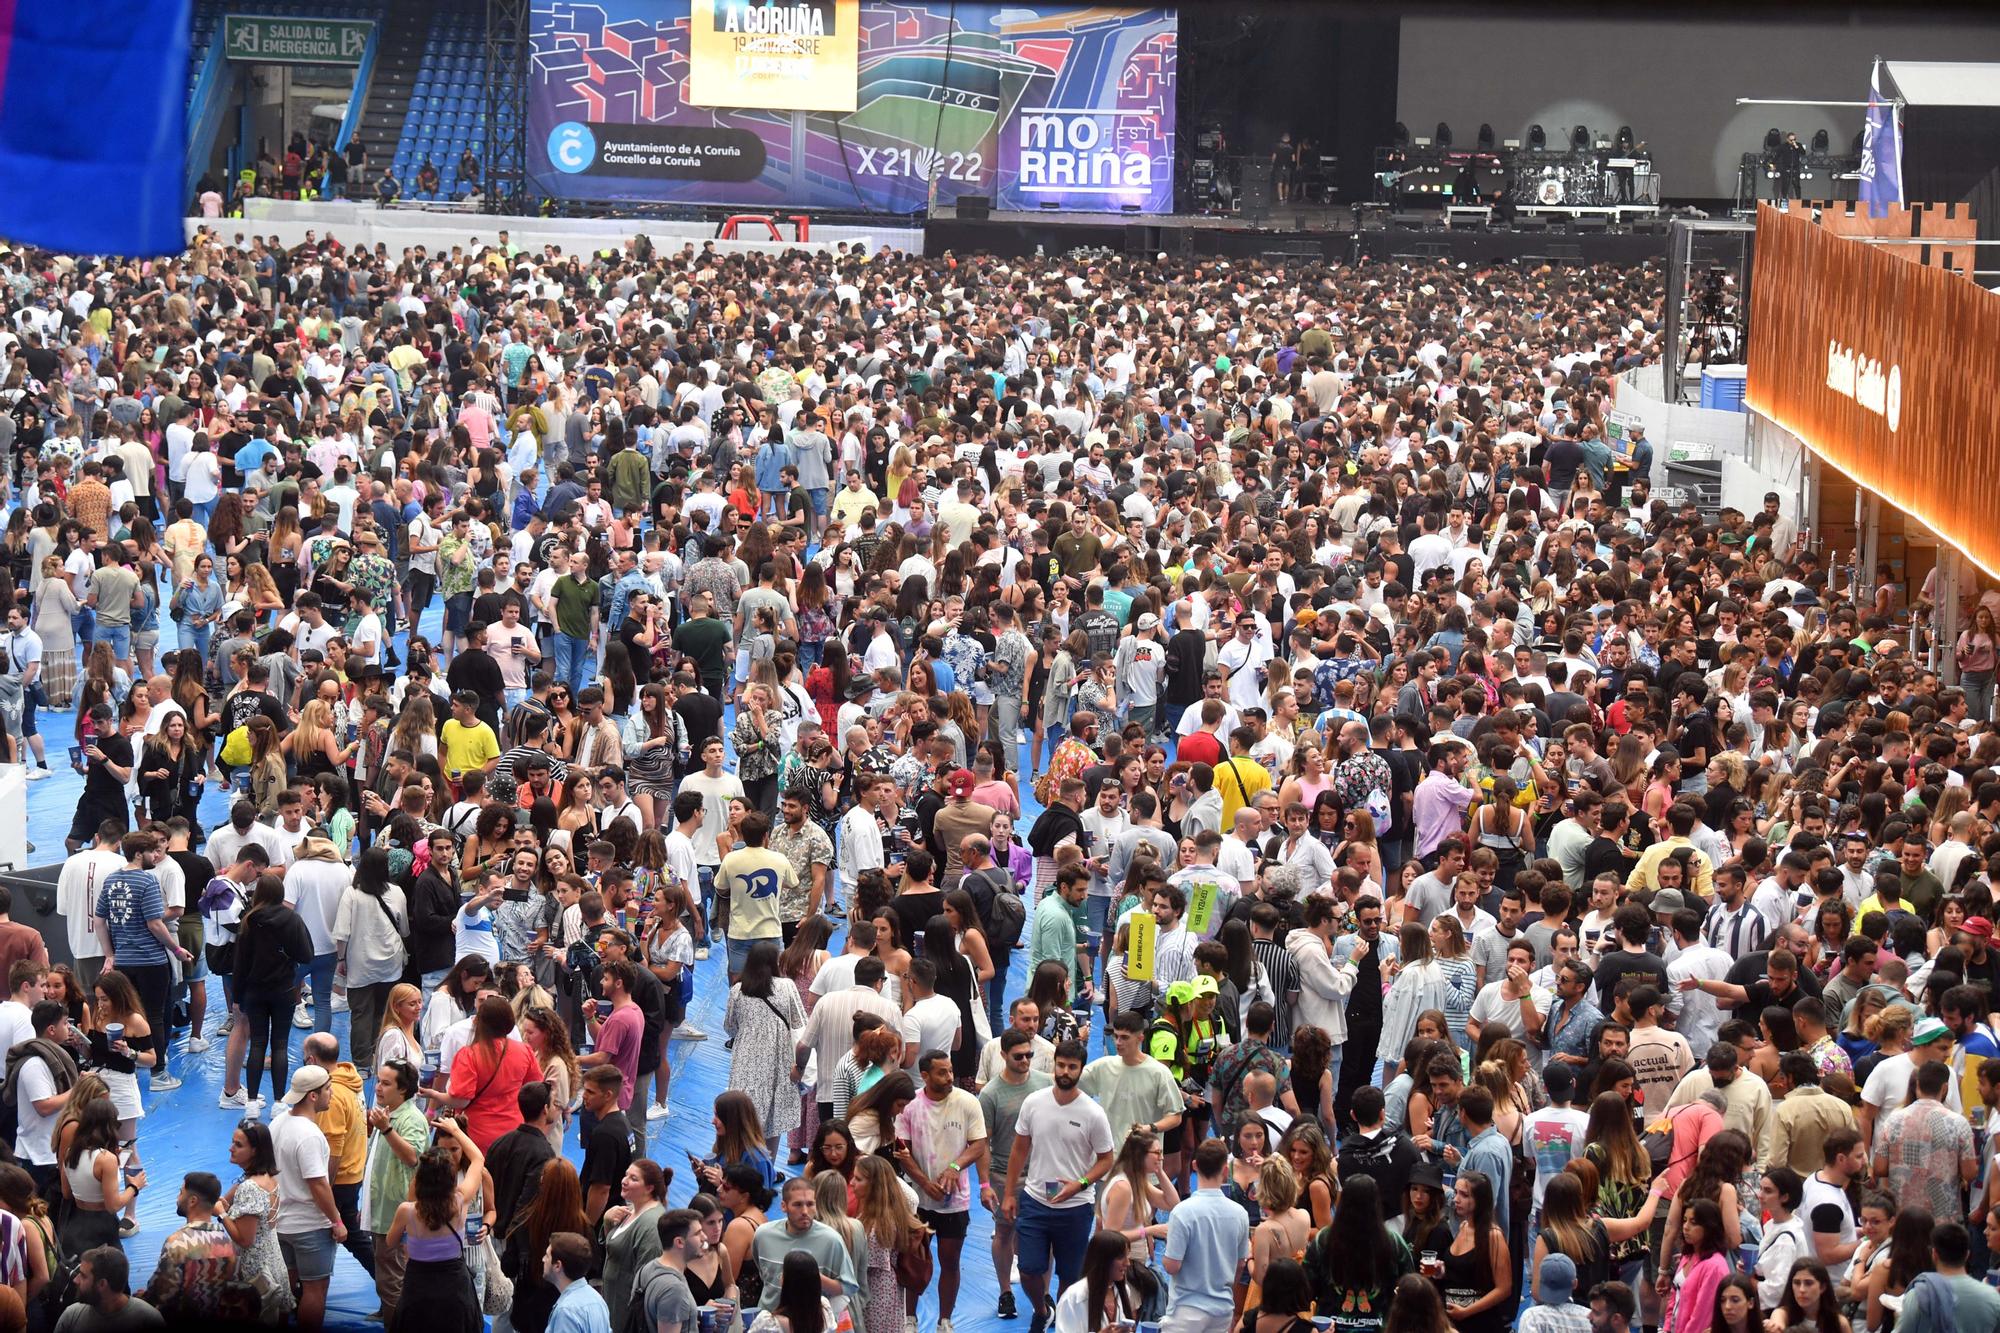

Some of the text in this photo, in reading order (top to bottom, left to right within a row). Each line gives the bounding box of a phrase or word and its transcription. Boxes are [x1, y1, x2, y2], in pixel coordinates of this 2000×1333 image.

[724, 3, 824, 36] A CORUÑA
[269, 25, 330, 41] SALIDA DE
[262, 41, 337, 56] EMERGENCIA
[1102, 127, 1152, 140] FEST
[603, 140, 741, 157] Ayuntamiento de A Coruña
[603, 153, 701, 167] Concello da Coruña
[949, 151, 983, 182] 22
[1633, 1053, 1669, 1068] actual
